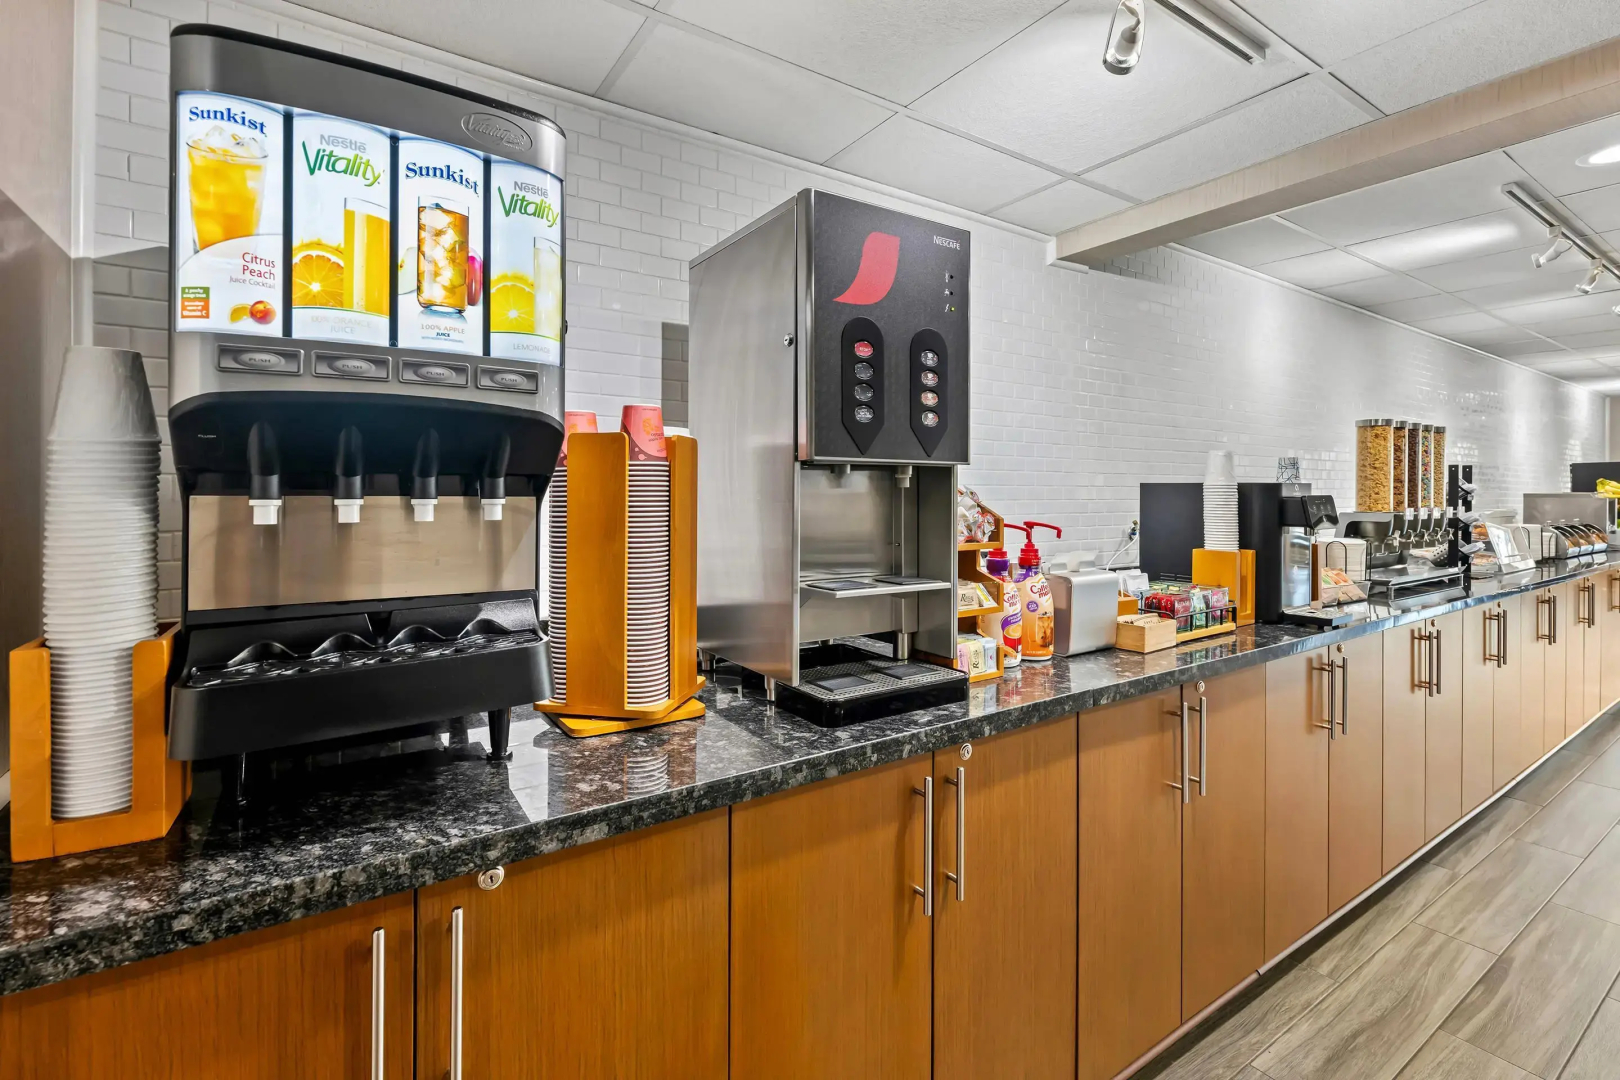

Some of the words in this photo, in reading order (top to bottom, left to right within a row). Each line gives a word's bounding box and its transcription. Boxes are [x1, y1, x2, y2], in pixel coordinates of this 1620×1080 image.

[188, 106, 266, 136] Sunkist
[302, 140, 381, 187] Vitality
[405, 162, 479, 195] Sunkist
[497, 185, 559, 228] Vitality
[242, 251, 276, 268] Citrus
[242, 264, 276, 280] Peach
[229, 275, 247, 284] Juice
[248, 278, 276, 290] Cocktail
[330, 325, 356, 334] JUICE
[332, 316, 372, 329] ORANGE
[421, 323, 442, 331] 100%
[443, 326, 466, 335] APPLE
